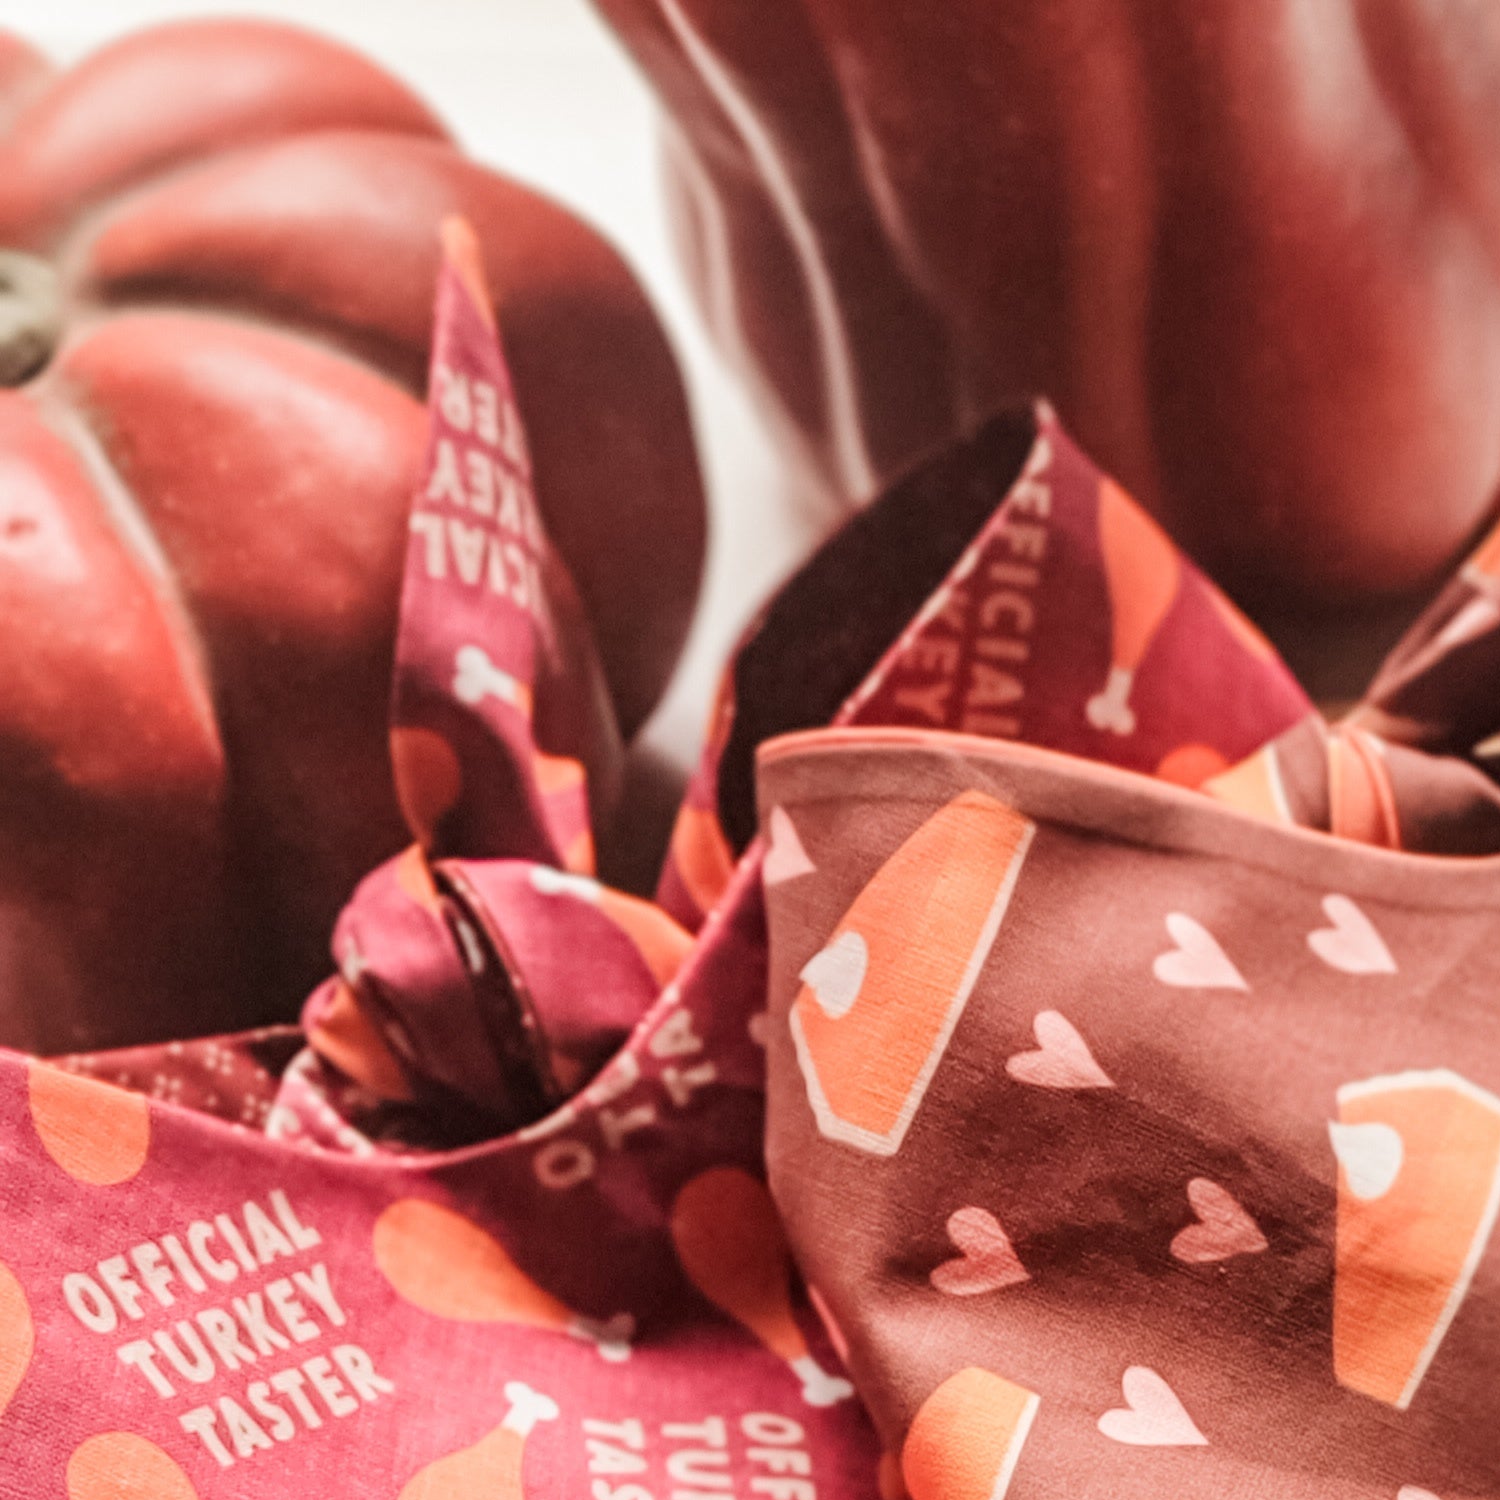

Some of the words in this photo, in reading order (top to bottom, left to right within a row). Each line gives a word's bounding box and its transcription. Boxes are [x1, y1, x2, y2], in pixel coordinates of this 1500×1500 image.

[62, 1190, 321, 1334] OFFICIAL
[117, 1262, 347, 1398] TURKEY
[180, 1344, 395, 1467] TASTER
